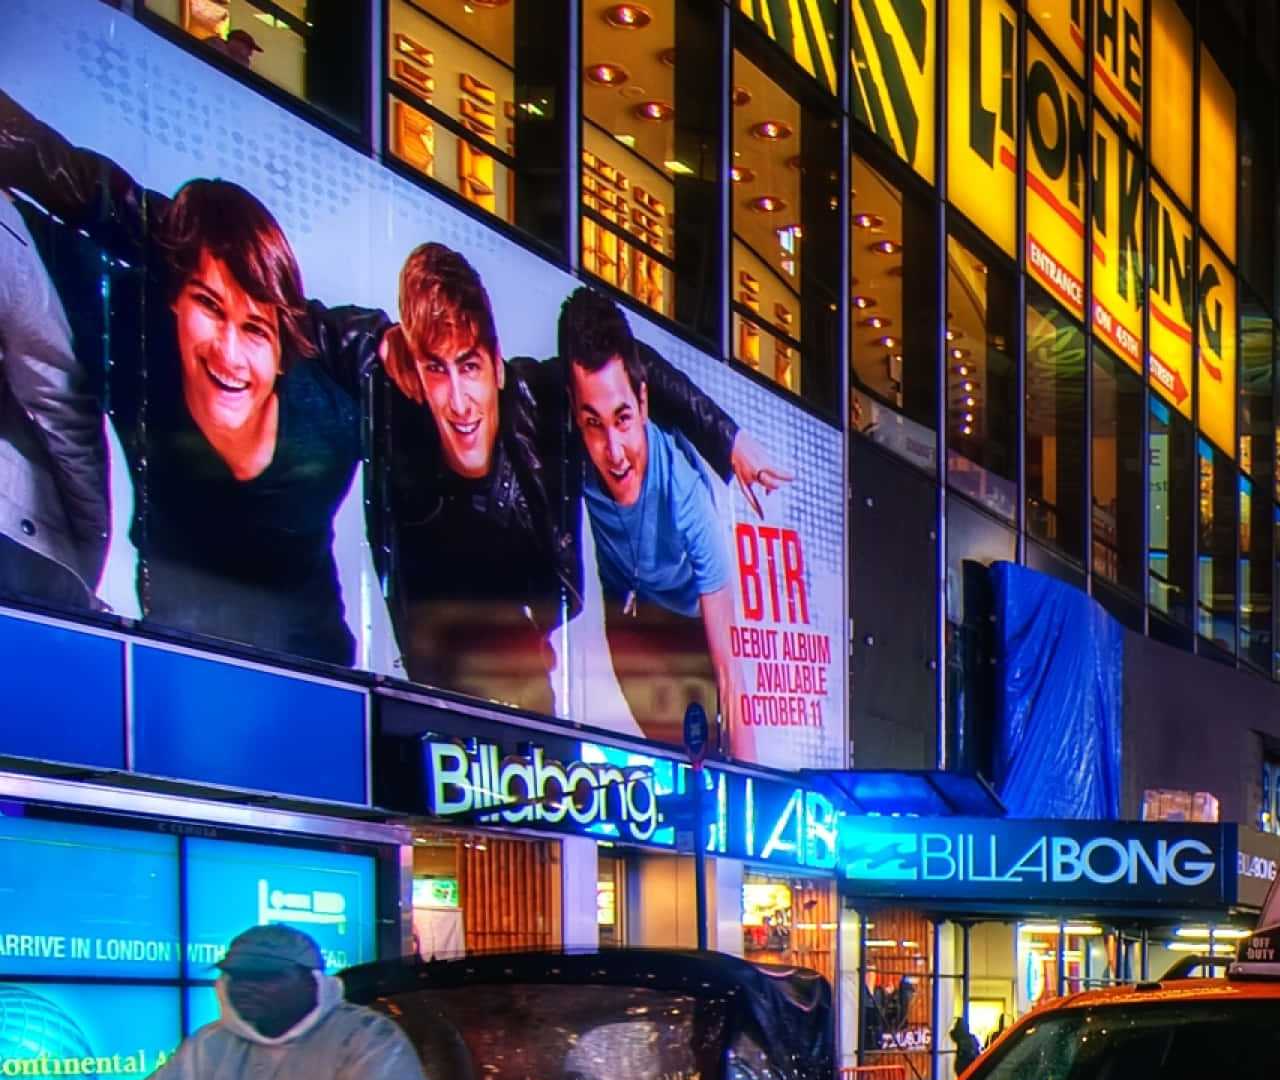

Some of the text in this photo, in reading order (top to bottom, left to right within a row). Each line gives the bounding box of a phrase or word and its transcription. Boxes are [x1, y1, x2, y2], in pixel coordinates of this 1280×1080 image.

[1070, 0, 1142, 105] HE
[1117, 113, 1223, 360] KING
[1030, 242, 1084, 305] ENTRANCE
[1094, 304, 1113, 332] ON
[1115, 323, 1141, 358] 45TH
[735, 522, 810, 625] BTR
[729, 625, 832, 665] DEBUT ALBUM
[756, 661, 828, 695] AVAILABLE
[740, 693, 823, 727] OCTOBER 11
[921, 832, 1216, 887] BILLABONG
[71, 937, 91, 959] IN
[95, 939, 170, 964] LONDON
[1246, 949, 1276, 962] DUTY
[1251, 936, 1272, 949] OFF
[2, 1049, 146, 1077] ontinental
